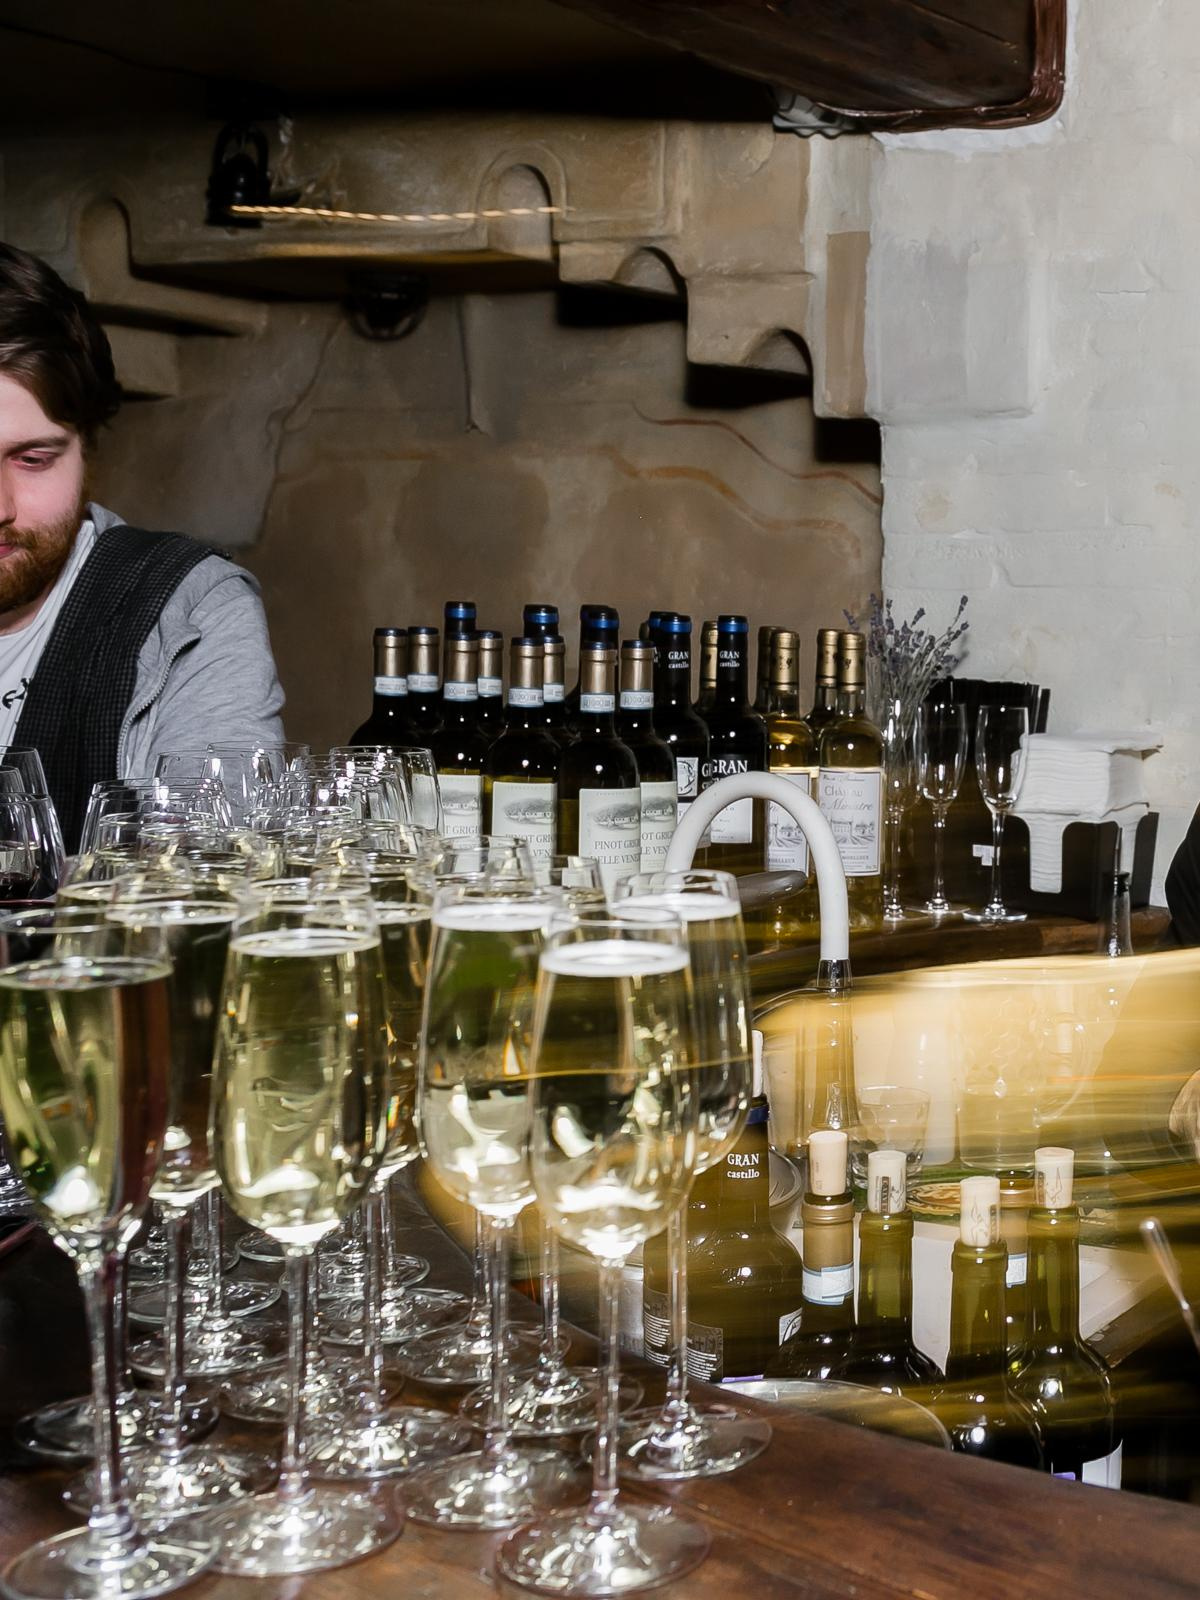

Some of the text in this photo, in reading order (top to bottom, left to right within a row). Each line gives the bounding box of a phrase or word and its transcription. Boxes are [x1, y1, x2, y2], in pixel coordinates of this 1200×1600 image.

[667, 651, 689, 660] GRAN
[719, 650, 740, 659] GRAN
[668, 661, 689, 669] castillo
[711, 759, 748, 775] GRAN
[594, 840, 623, 850] PINOT
[727, 1153, 760, 1167] GRAN
[726, 1168, 760, 1179] castillo
